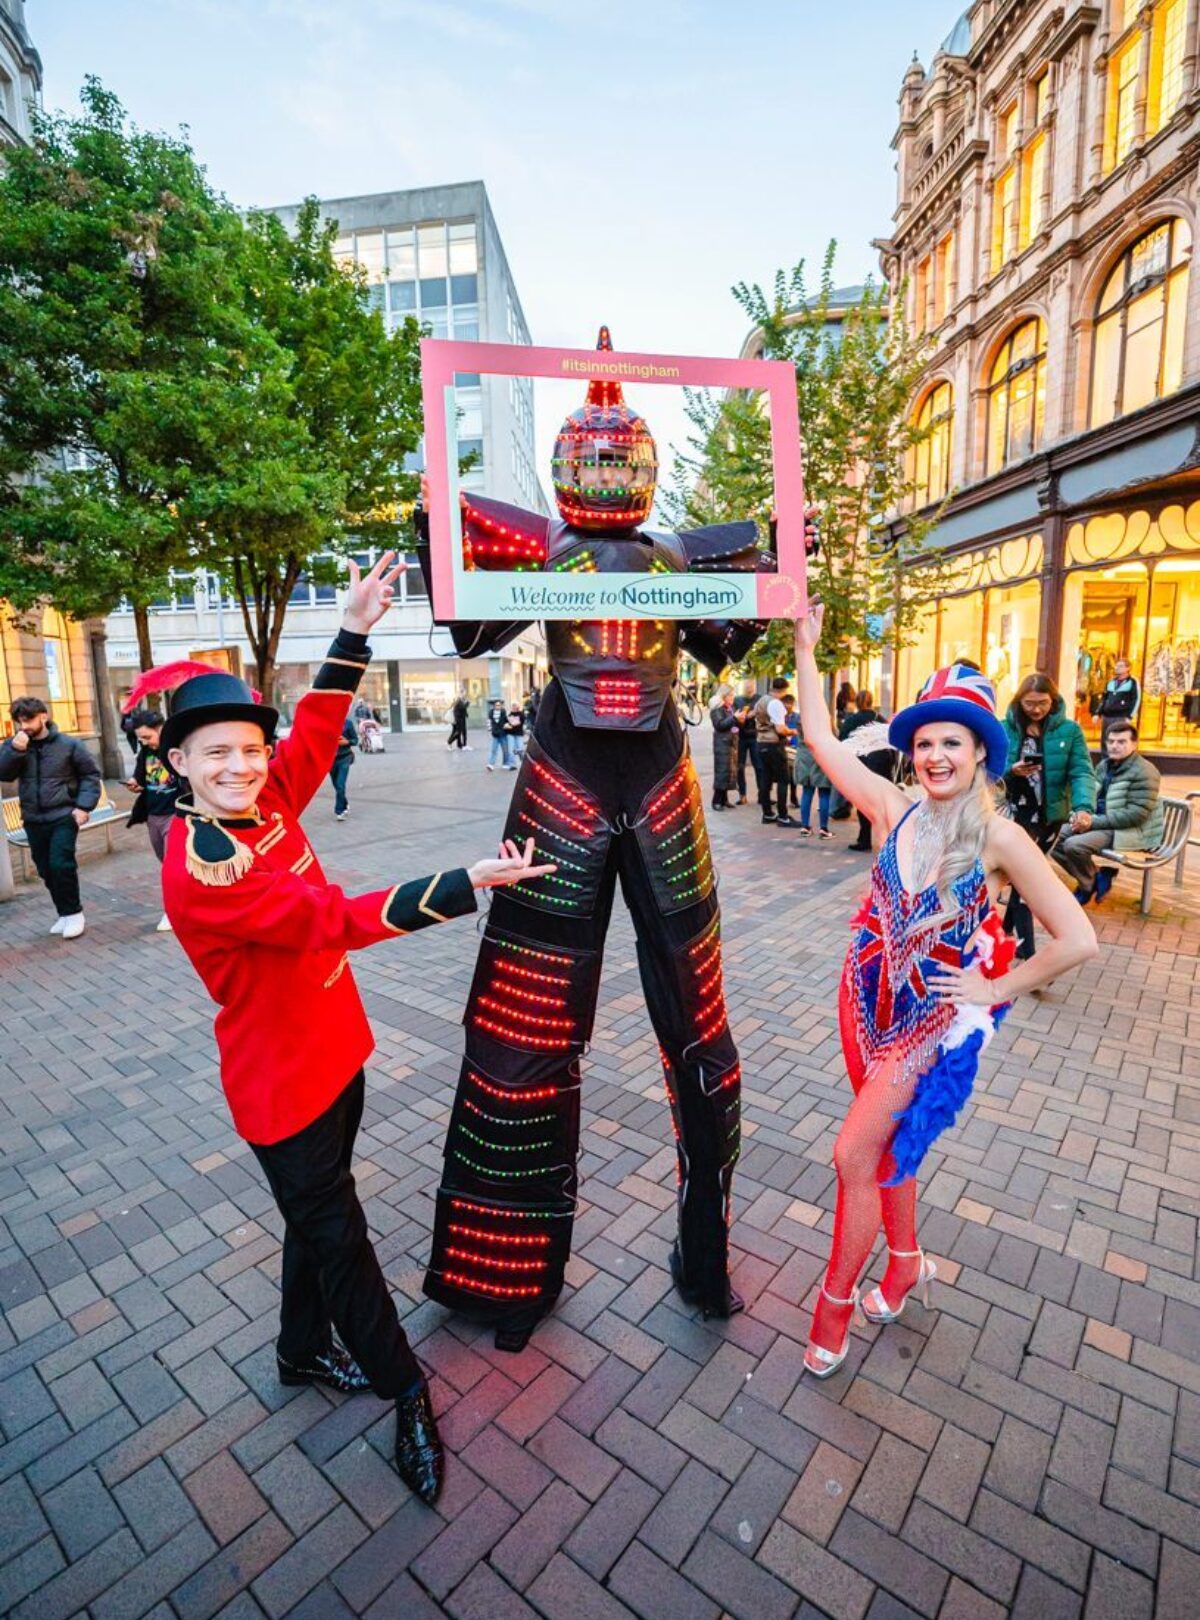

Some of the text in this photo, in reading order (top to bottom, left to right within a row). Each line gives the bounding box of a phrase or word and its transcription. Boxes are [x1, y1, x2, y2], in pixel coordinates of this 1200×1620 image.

[561, 358, 680, 378] #itsinnottingham
[511, 587, 737, 609] Welcome to Nottingham
